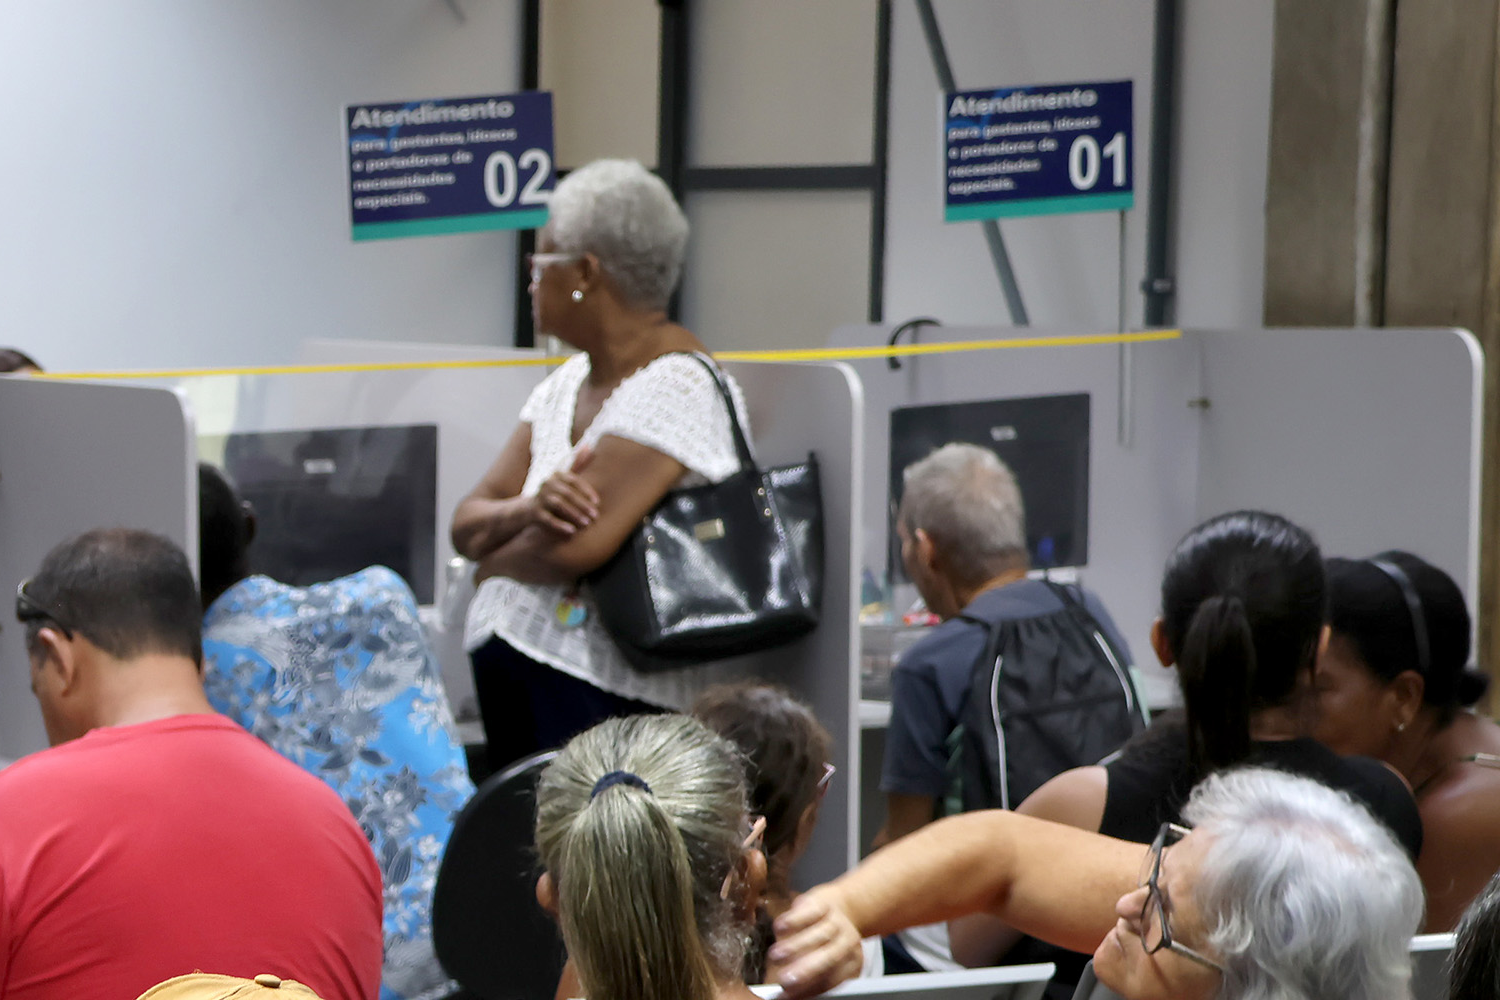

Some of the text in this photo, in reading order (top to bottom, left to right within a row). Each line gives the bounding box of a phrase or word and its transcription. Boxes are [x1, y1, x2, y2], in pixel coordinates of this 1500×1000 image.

[351, 99, 515, 130] Atendimento
[949, 88, 1098, 117] Atendimento
[483, 148, 552, 208] 02
[1068, 131, 1127, 190] 01
